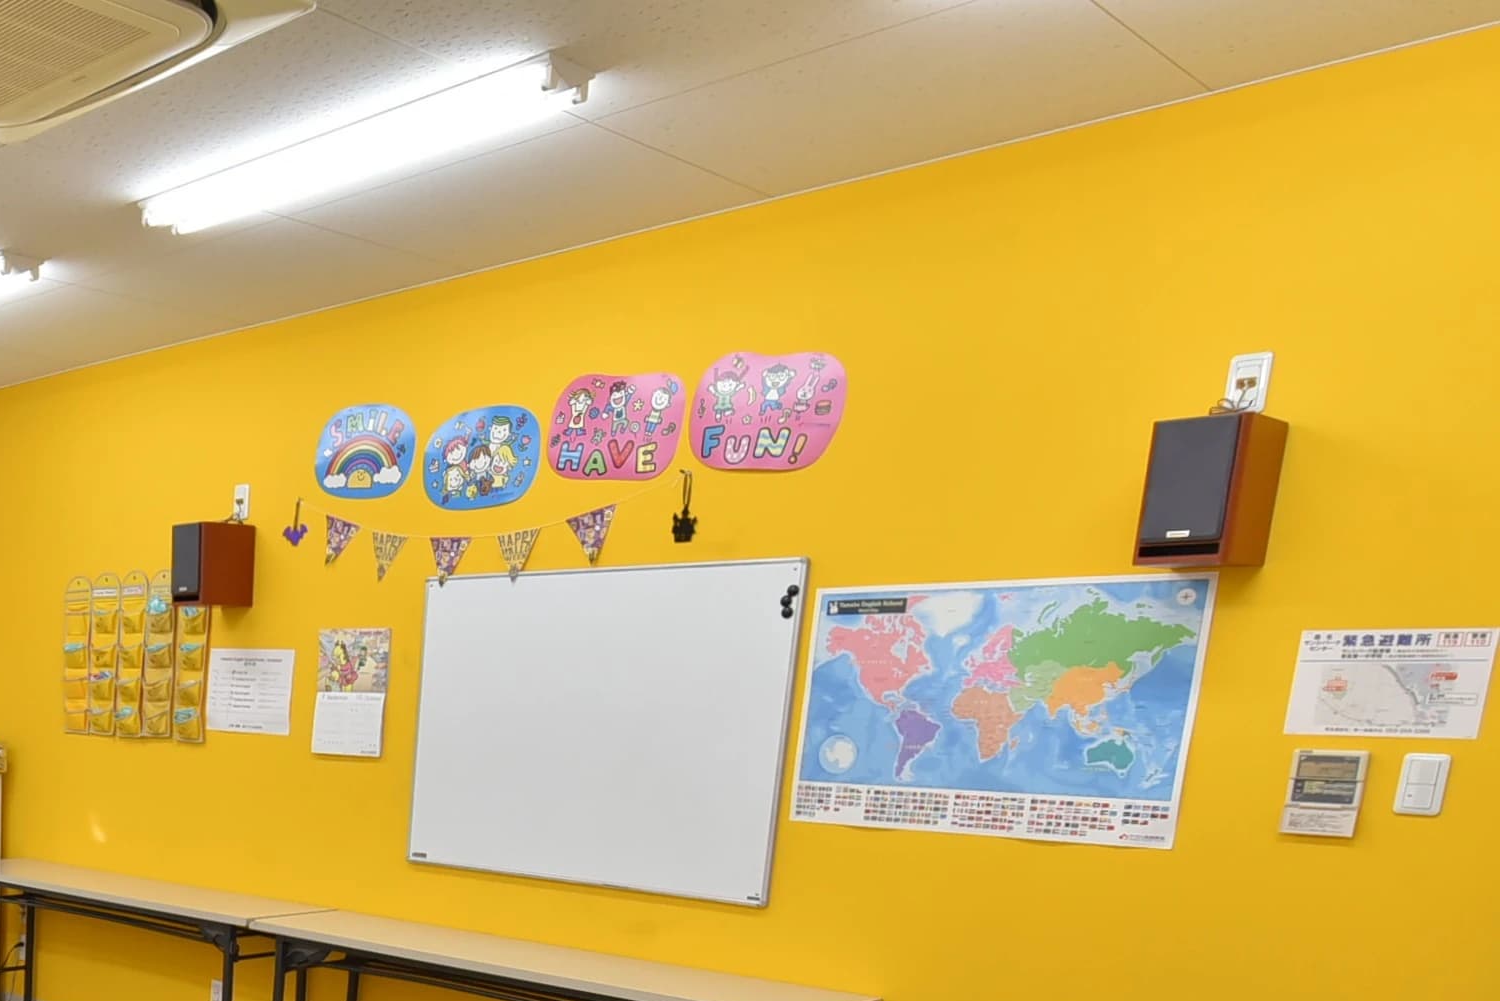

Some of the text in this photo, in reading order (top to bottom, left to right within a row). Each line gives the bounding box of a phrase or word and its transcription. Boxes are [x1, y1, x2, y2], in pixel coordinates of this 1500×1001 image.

[329, 408, 405, 449] SMILE
[700, 424, 809, 465] FUN!
[555, 439, 658, 477] HAVE
[497, 528, 538, 546] HAPPY
